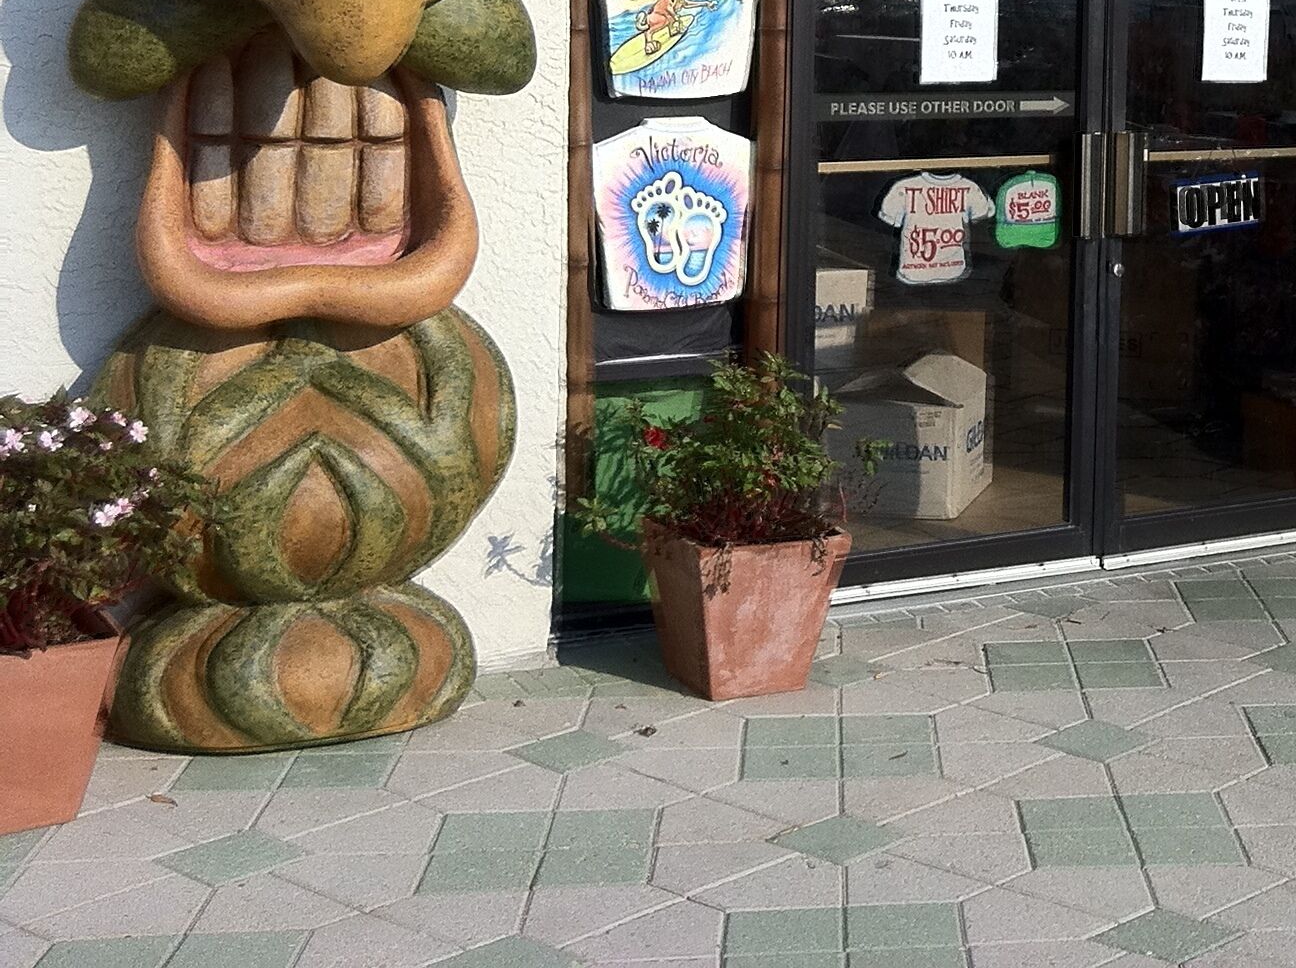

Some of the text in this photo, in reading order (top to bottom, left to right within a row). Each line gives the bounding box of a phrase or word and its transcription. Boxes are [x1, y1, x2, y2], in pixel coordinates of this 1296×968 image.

[700, 59, 733, 84] BEACH
[830, 99, 1016, 115] PLEASE USE OTHER DOOR
[629, 135, 724, 174] Victoria
[904, 186, 923, 214] T
[1017, 189, 1049, 200] BLANK
[1179, 179, 1259, 229] OPEN
